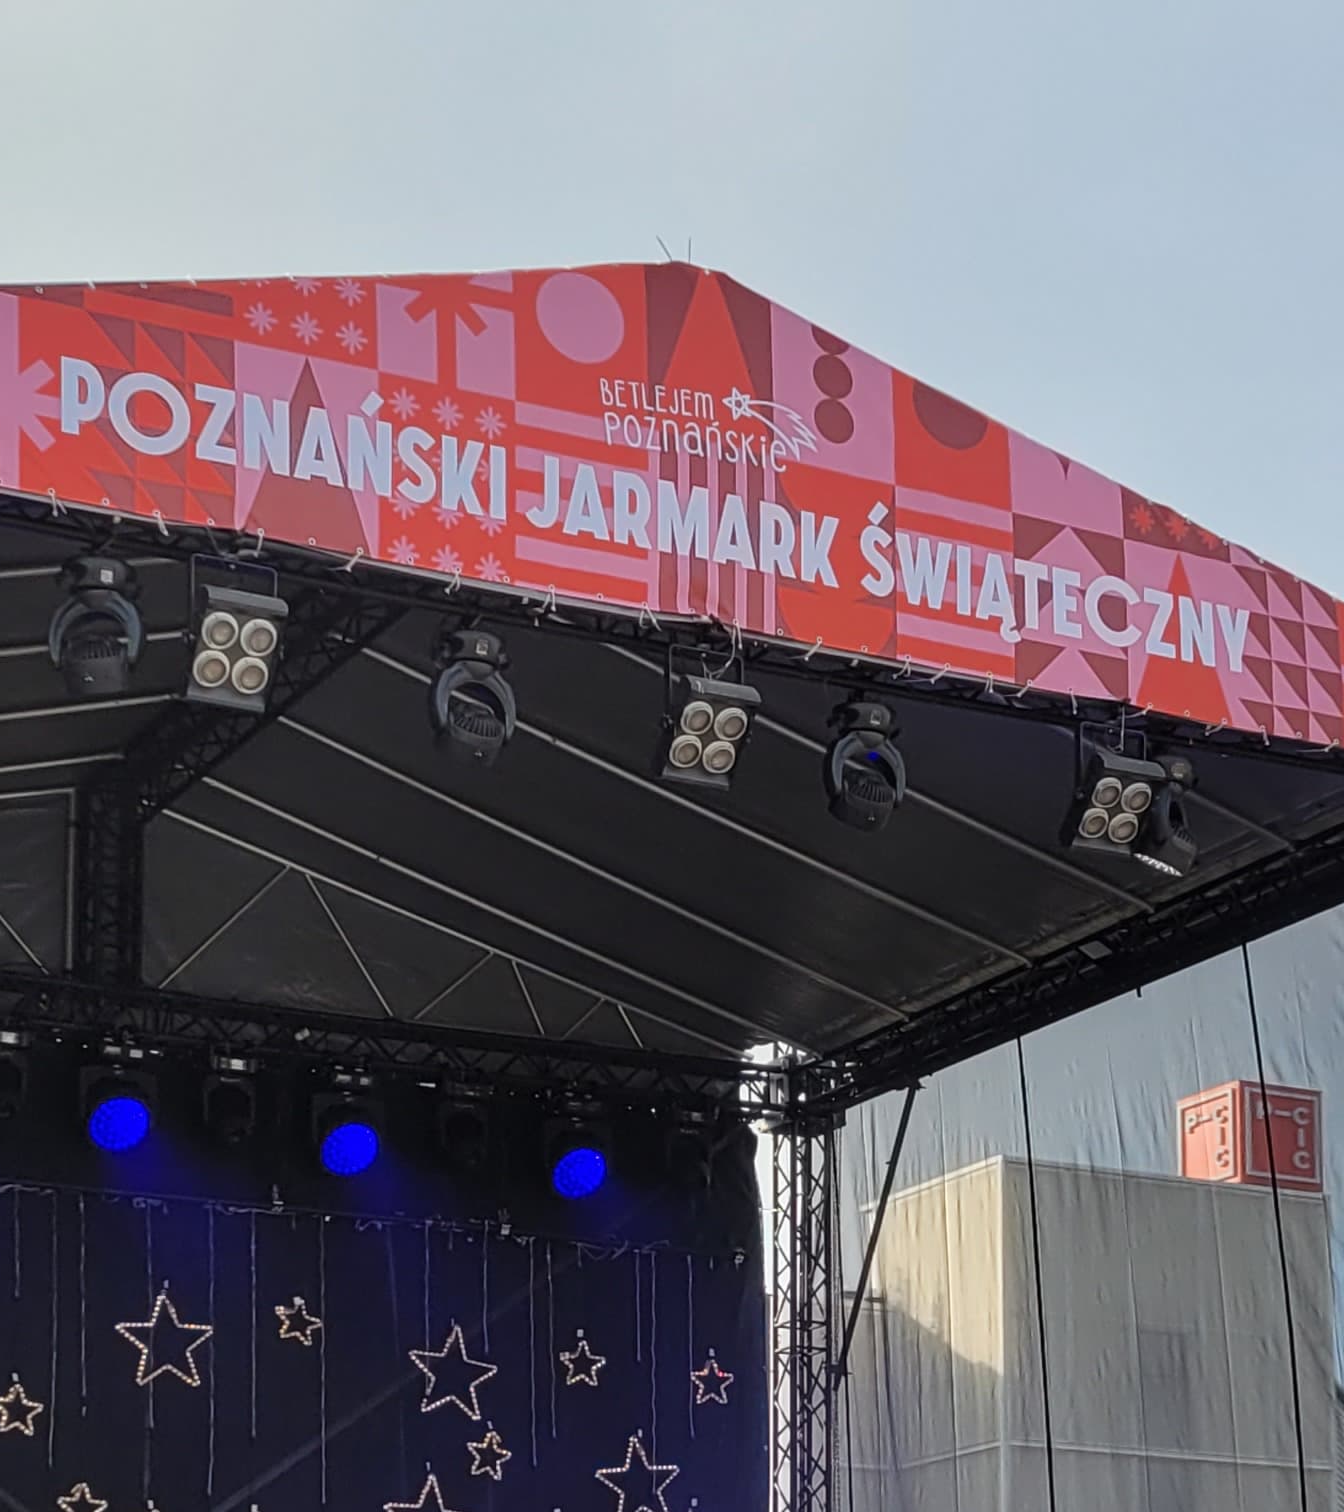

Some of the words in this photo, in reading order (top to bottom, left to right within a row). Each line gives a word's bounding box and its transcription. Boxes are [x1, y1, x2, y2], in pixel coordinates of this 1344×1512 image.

[60, 355, 507, 521] POZNAŃSKI
[525, 455, 840, 589] JARMARK
[859, 501, 1250, 673] ŚWIĄTECZNY
